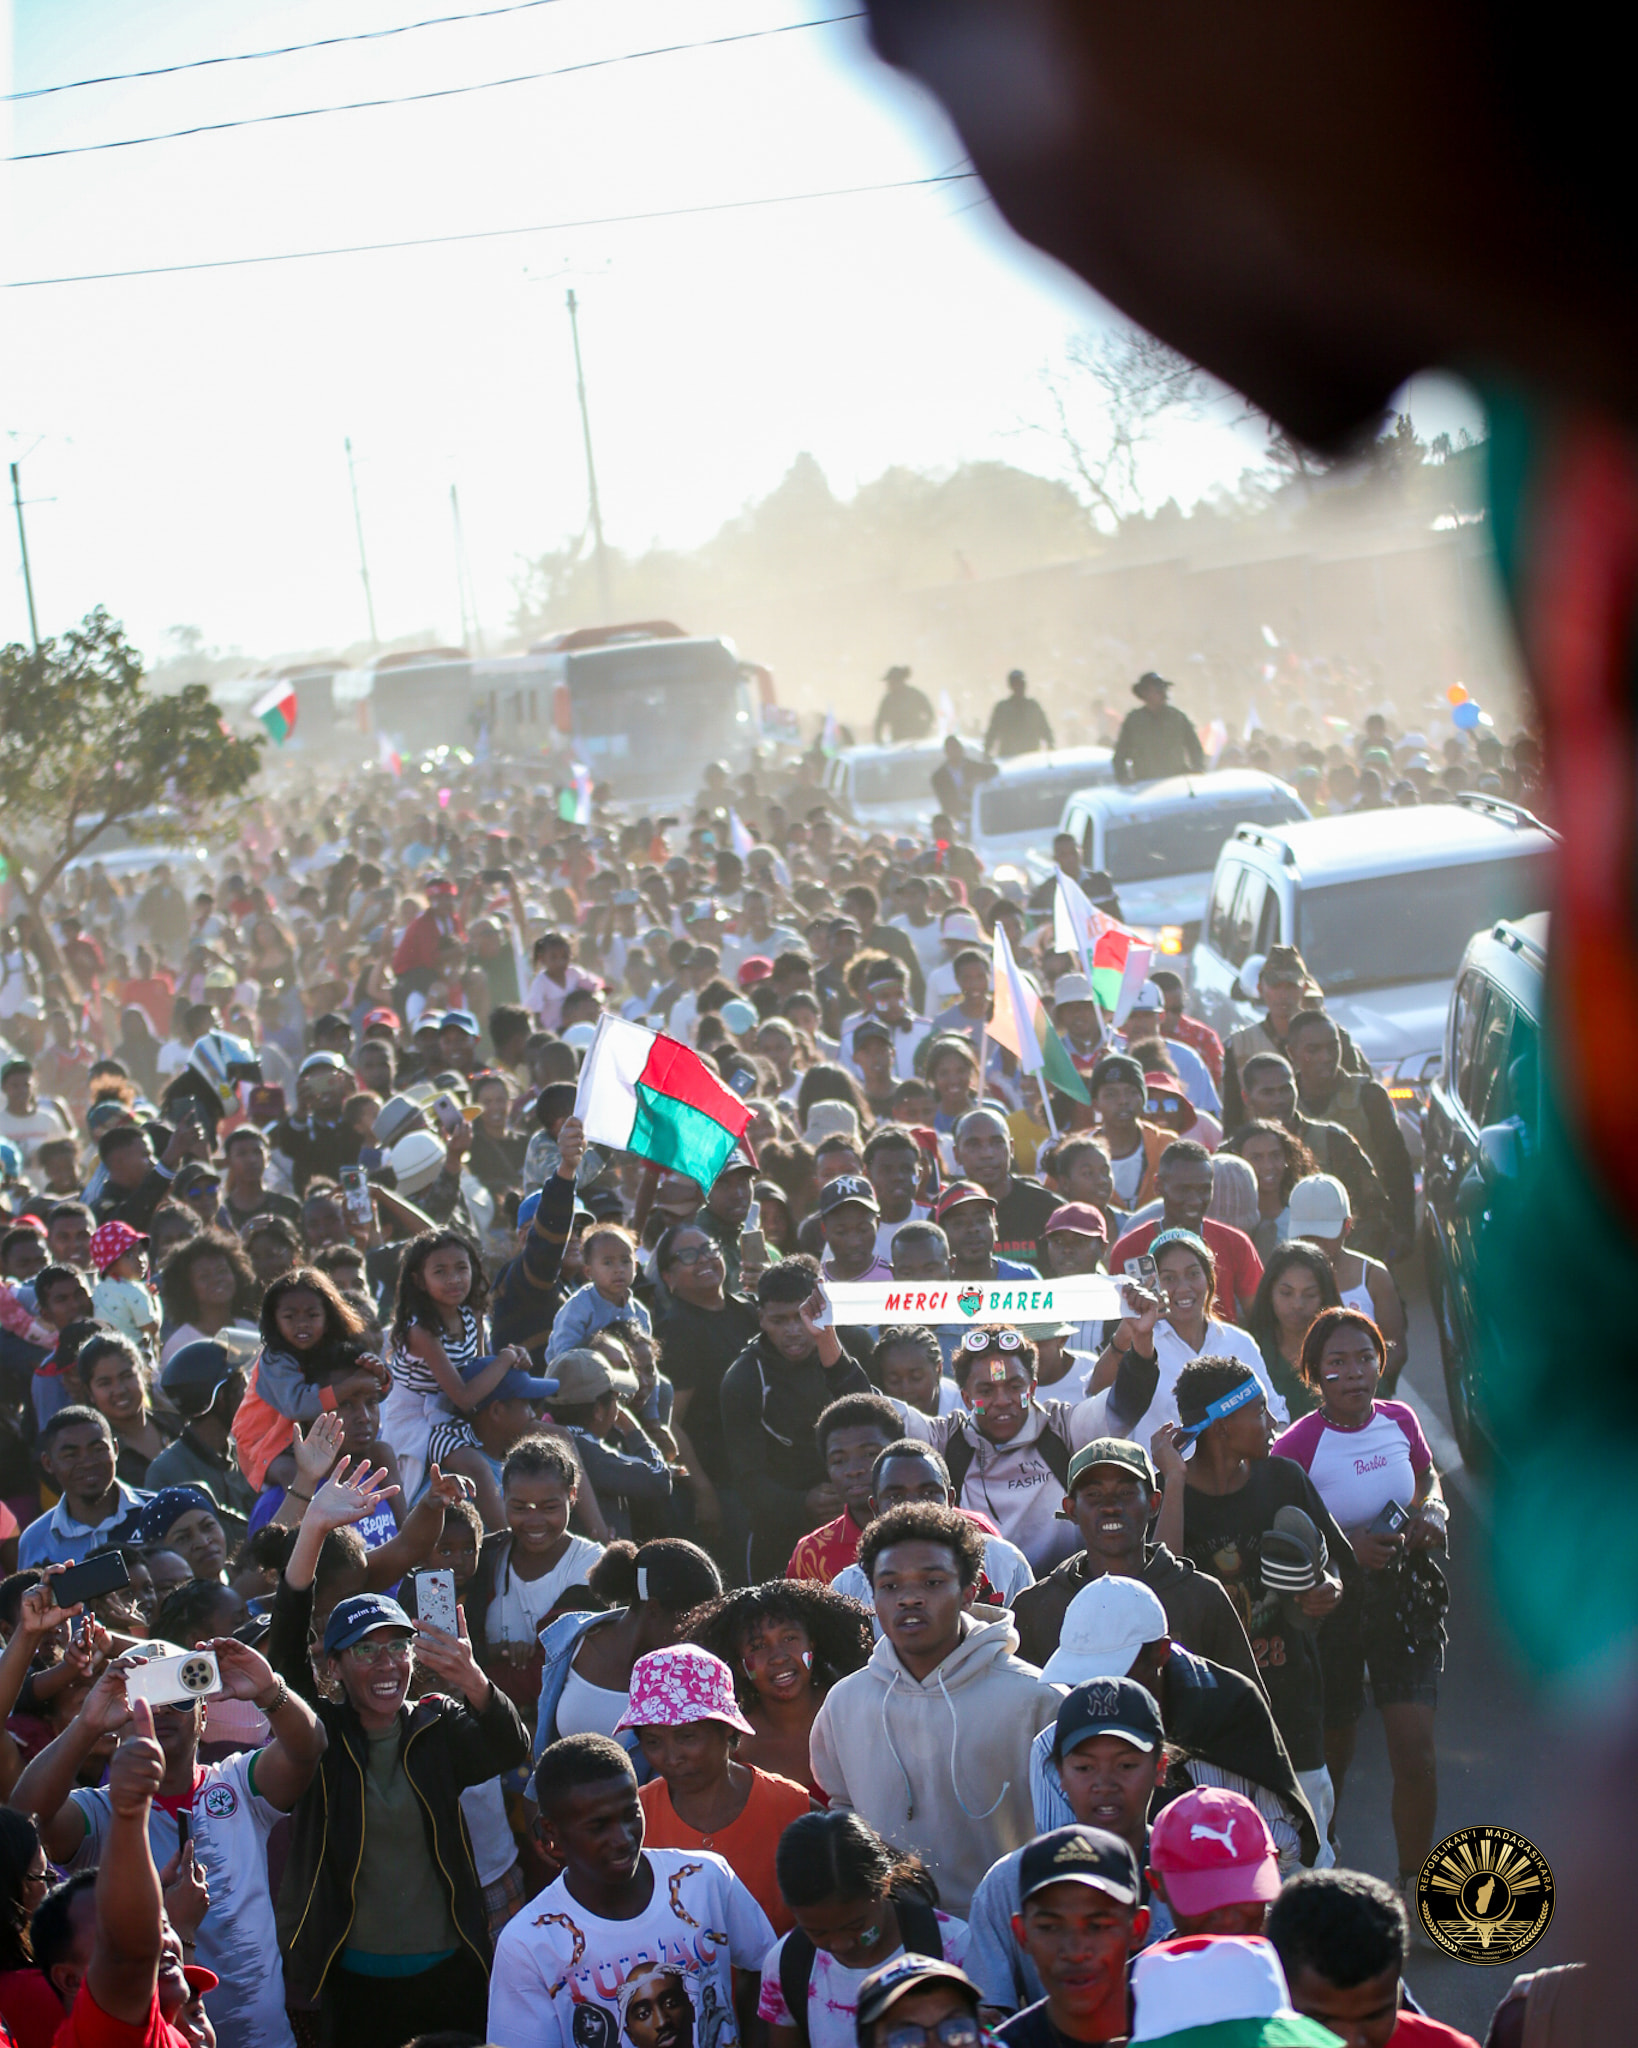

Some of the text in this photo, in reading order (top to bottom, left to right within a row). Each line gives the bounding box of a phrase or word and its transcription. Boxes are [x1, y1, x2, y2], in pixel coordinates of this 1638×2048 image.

[885, 1291, 1053, 1311] MERCI BAREA
[1353, 1455, 1387, 1476] Barbie
[1252, 1636, 1286, 1668] 28
